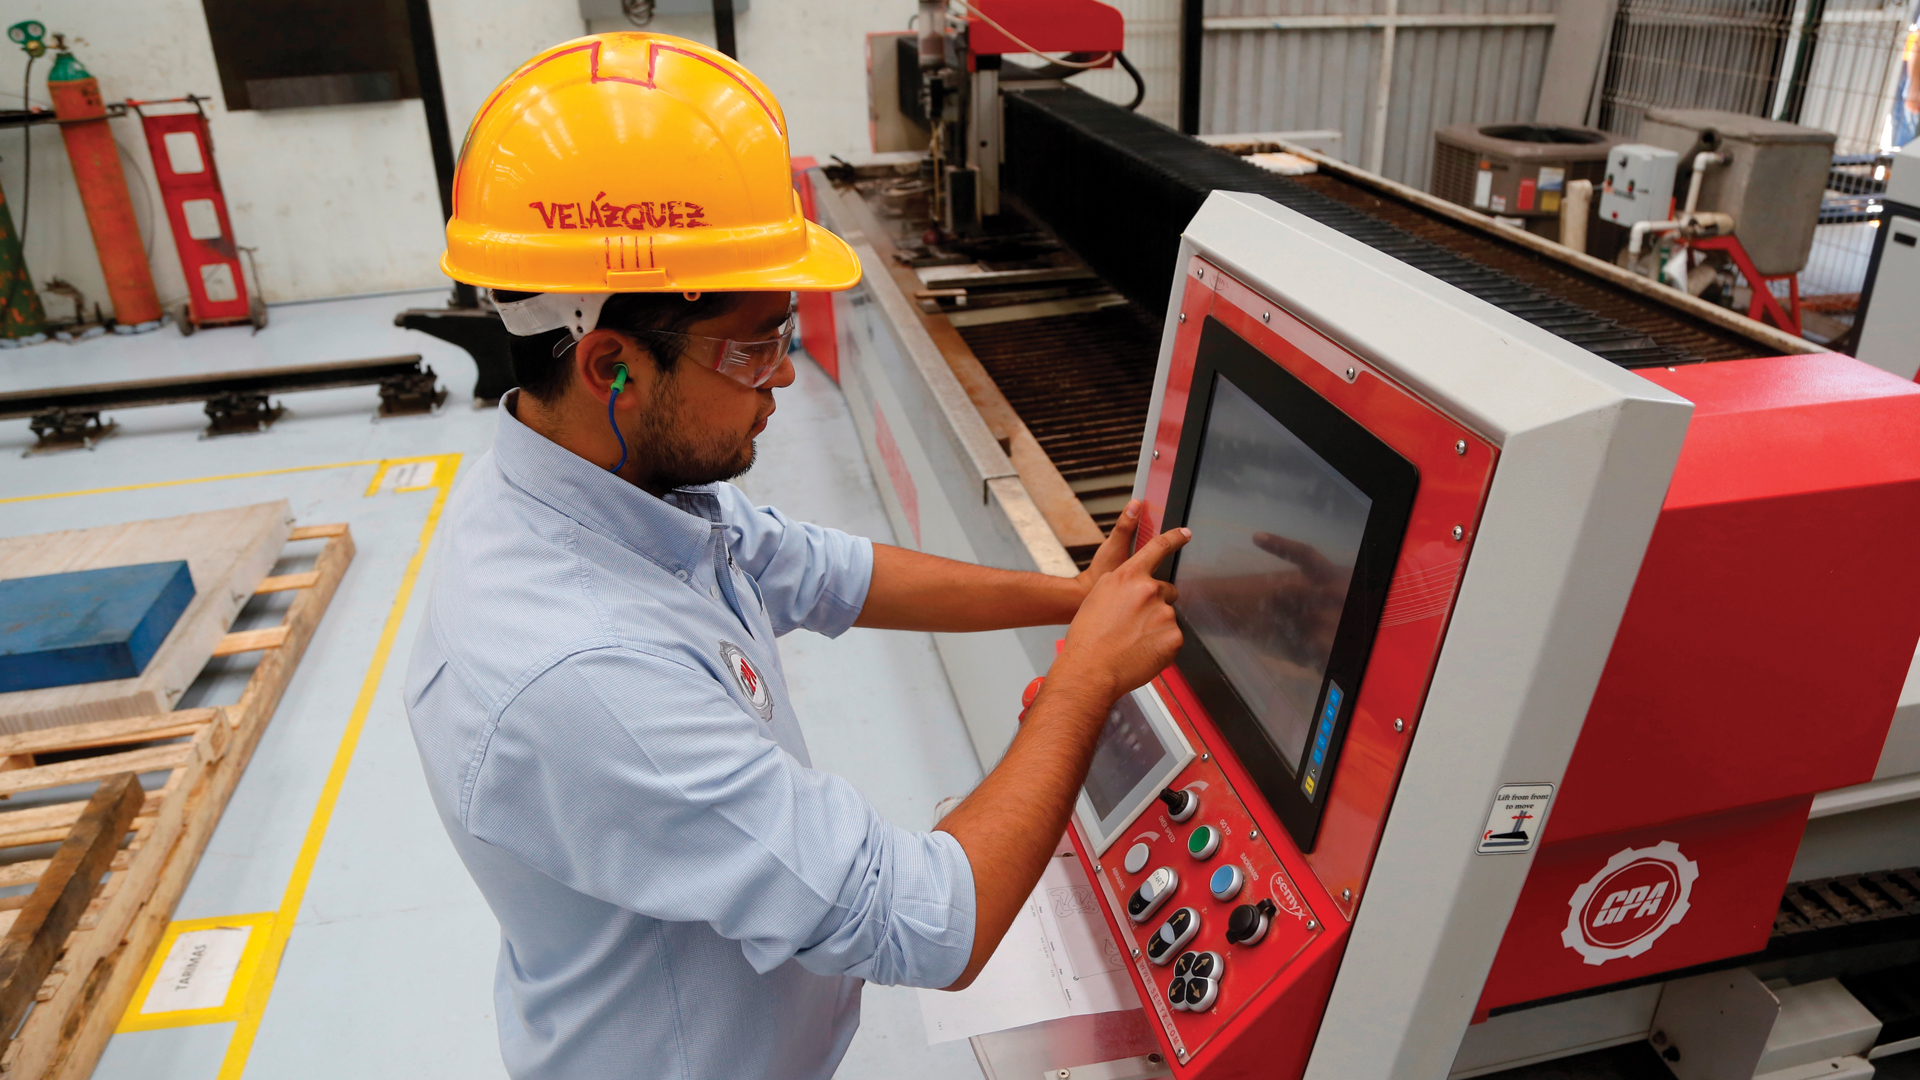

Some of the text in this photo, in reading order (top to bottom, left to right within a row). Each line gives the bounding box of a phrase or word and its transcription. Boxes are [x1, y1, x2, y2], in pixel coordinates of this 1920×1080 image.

[529, 191, 707, 230] VELÁZQUEZ
[1497, 793, 1511, 801] Lift
[1511, 793, 1529, 801] from
[1158, 815, 1176, 843] OVER SPEED
[1219, 818, 1232, 836] GO TO
[1111, 867, 1126, 892] ABRASIVE
[1152, 871, 1165, 887] START
[1239, 852, 1260, 882] BACKWARD
[1275, 875, 1307, 921] semyx
[1592, 880, 1670, 928] GPA
[174, 944, 208, 992] TARIMAS
[1139, 961, 1180, 1046] WWW.SEMYX.COM
